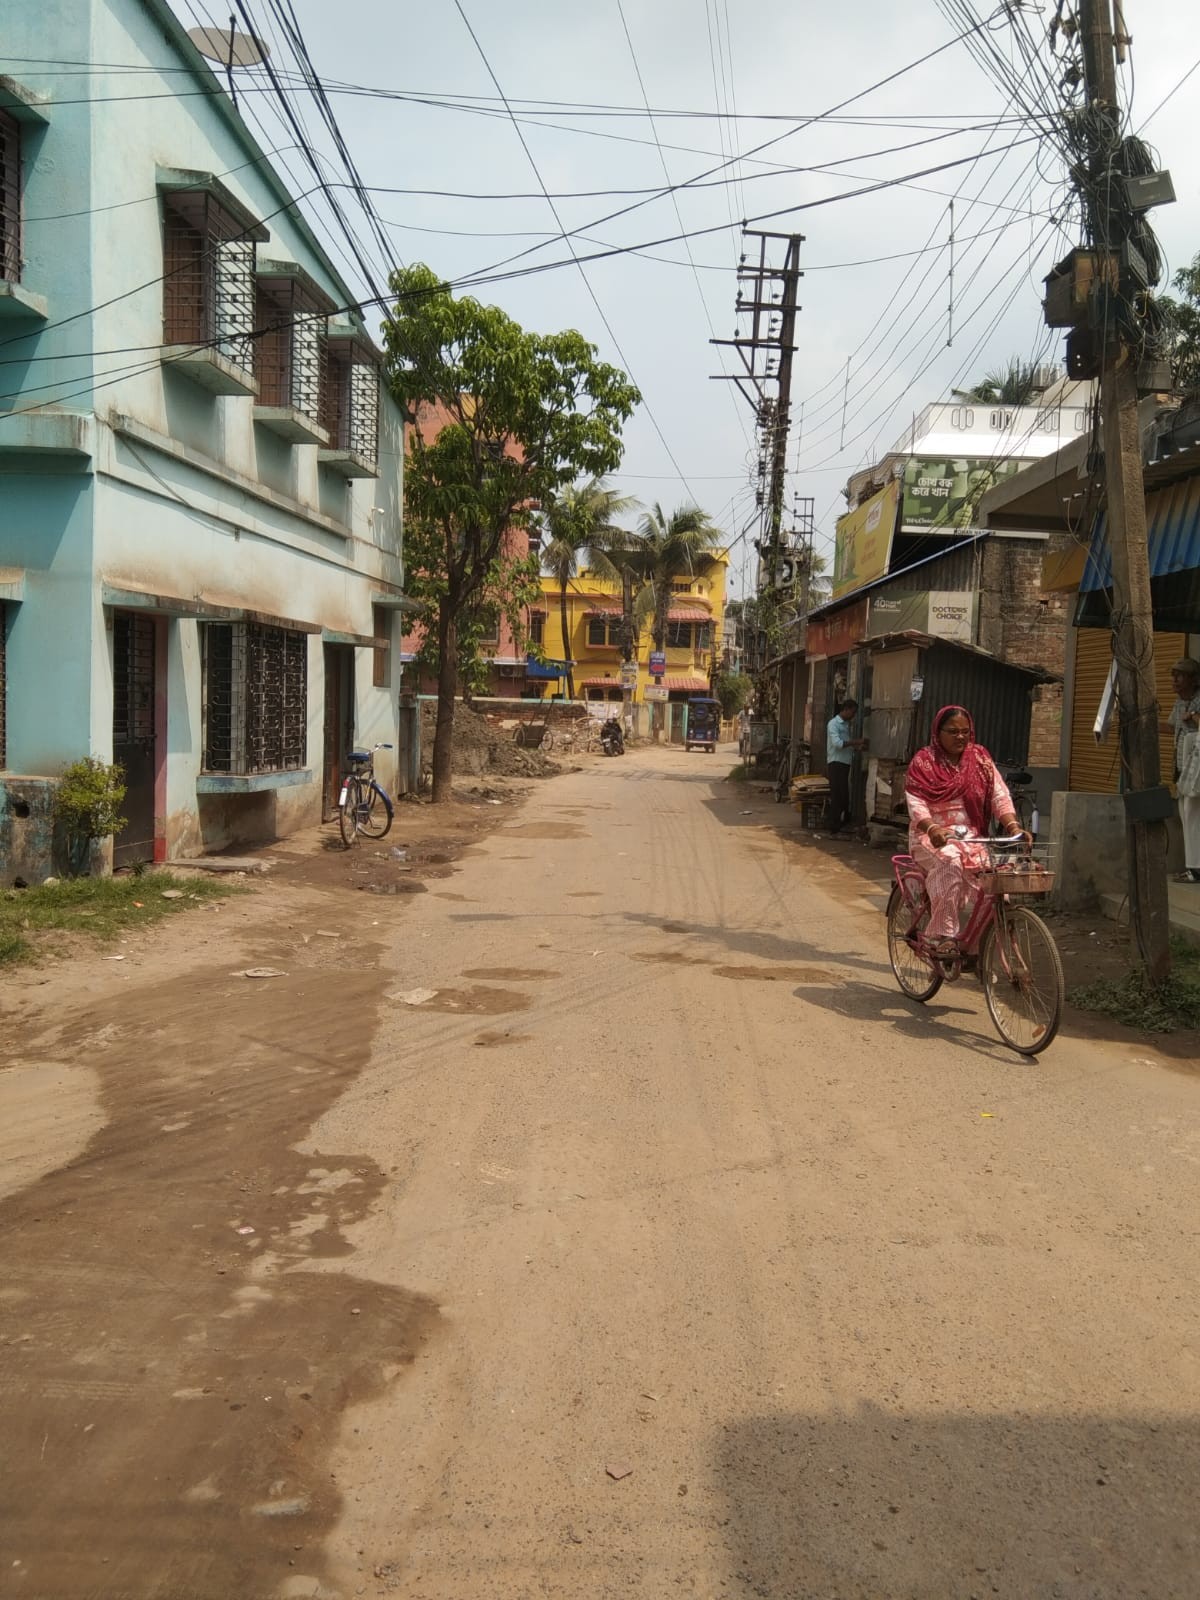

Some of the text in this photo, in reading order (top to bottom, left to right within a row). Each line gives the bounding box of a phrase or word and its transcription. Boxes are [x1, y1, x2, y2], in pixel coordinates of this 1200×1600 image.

[918, 477, 937, 487] চোখ
[911, 487, 949, 497] করে খান
[873, 599, 886, 608] 40
